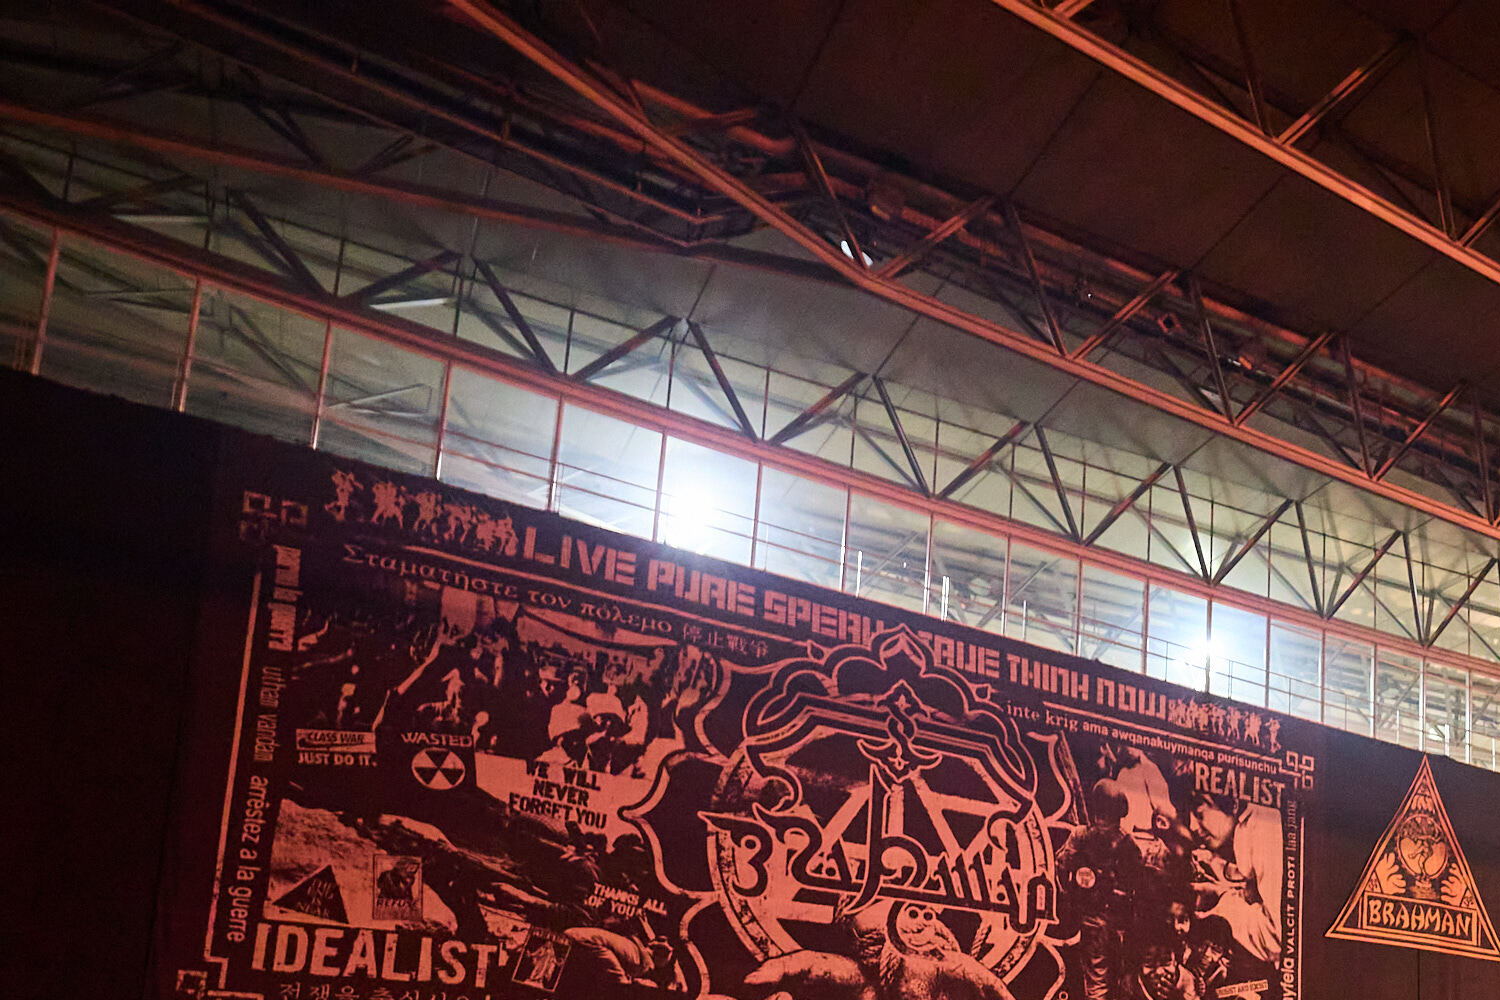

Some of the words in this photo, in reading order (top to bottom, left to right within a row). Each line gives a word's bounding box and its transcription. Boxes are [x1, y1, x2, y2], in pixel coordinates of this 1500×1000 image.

[523, 526, 637, 586] LIVE
[527, 590, 572, 609] τον
[1006, 700, 1040, 722] inte
[1045, 708, 1079, 733] krig
[1082, 721, 1110, 737] ama
[401, 732, 473, 747] WASTED
[298, 752, 330, 764] JUST
[334, 753, 355, 766] DO
[358, 754, 378, 767] IT.
[533, 778, 590, 807] NEVER
[563, 766, 601, 791] WILL
[1194, 760, 1286, 809] REALIST
[509, 792, 573, 821] FORGET
[576, 807, 607, 830] YOU
[1286, 856, 1296, 899] PROTI
[588, 896, 606, 908] OF
[594, 882, 639, 906] THANKS
[643, 898, 668, 915] ALL
[1286, 905, 1296, 957] VALCIT
[1368, 898, 1472, 938] BRAHMAN
[251, 922, 498, 989] IDEALIST
